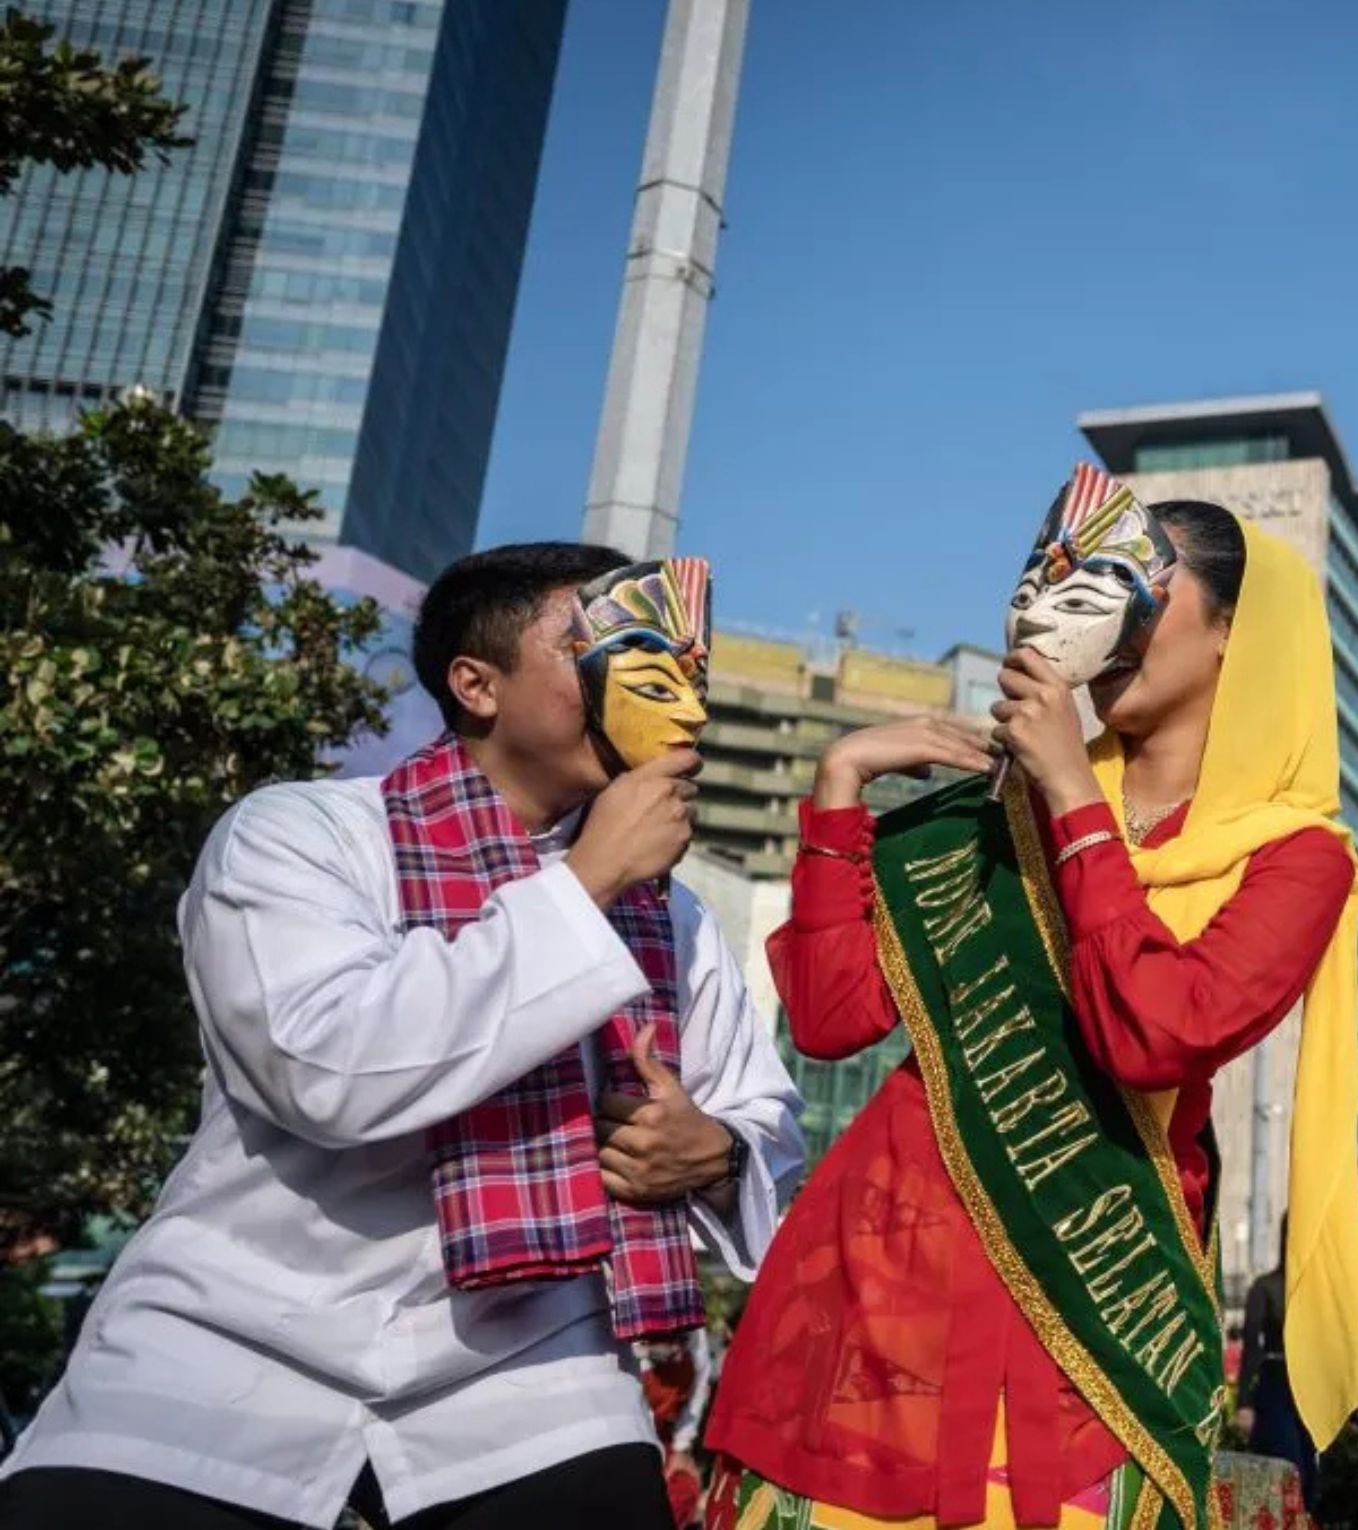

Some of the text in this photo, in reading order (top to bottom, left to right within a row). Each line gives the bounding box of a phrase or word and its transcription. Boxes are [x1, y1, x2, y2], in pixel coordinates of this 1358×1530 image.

[904, 839, 992, 966] NONE
[952, 954, 1099, 1192] JAKARTA
[1053, 1184, 1204, 1397] SELATAN
